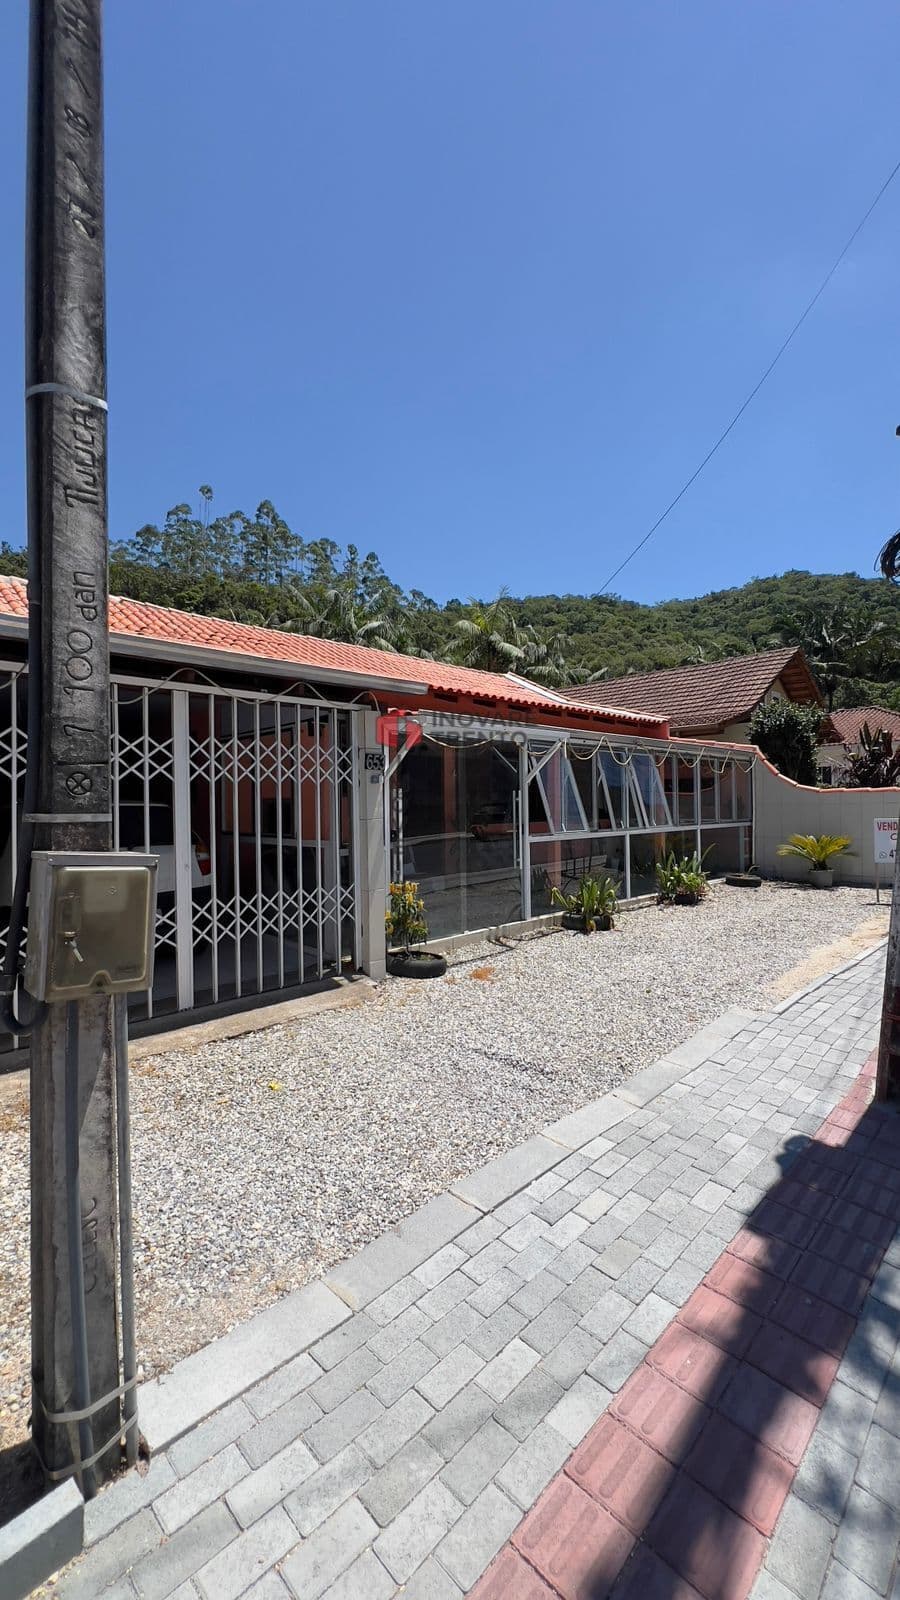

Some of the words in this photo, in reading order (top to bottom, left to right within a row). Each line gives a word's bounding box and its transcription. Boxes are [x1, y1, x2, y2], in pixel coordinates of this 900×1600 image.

[63, 629, 94, 696] 100
[366, 754, 385, 770] 653
[876, 821, 898, 831] VEND
